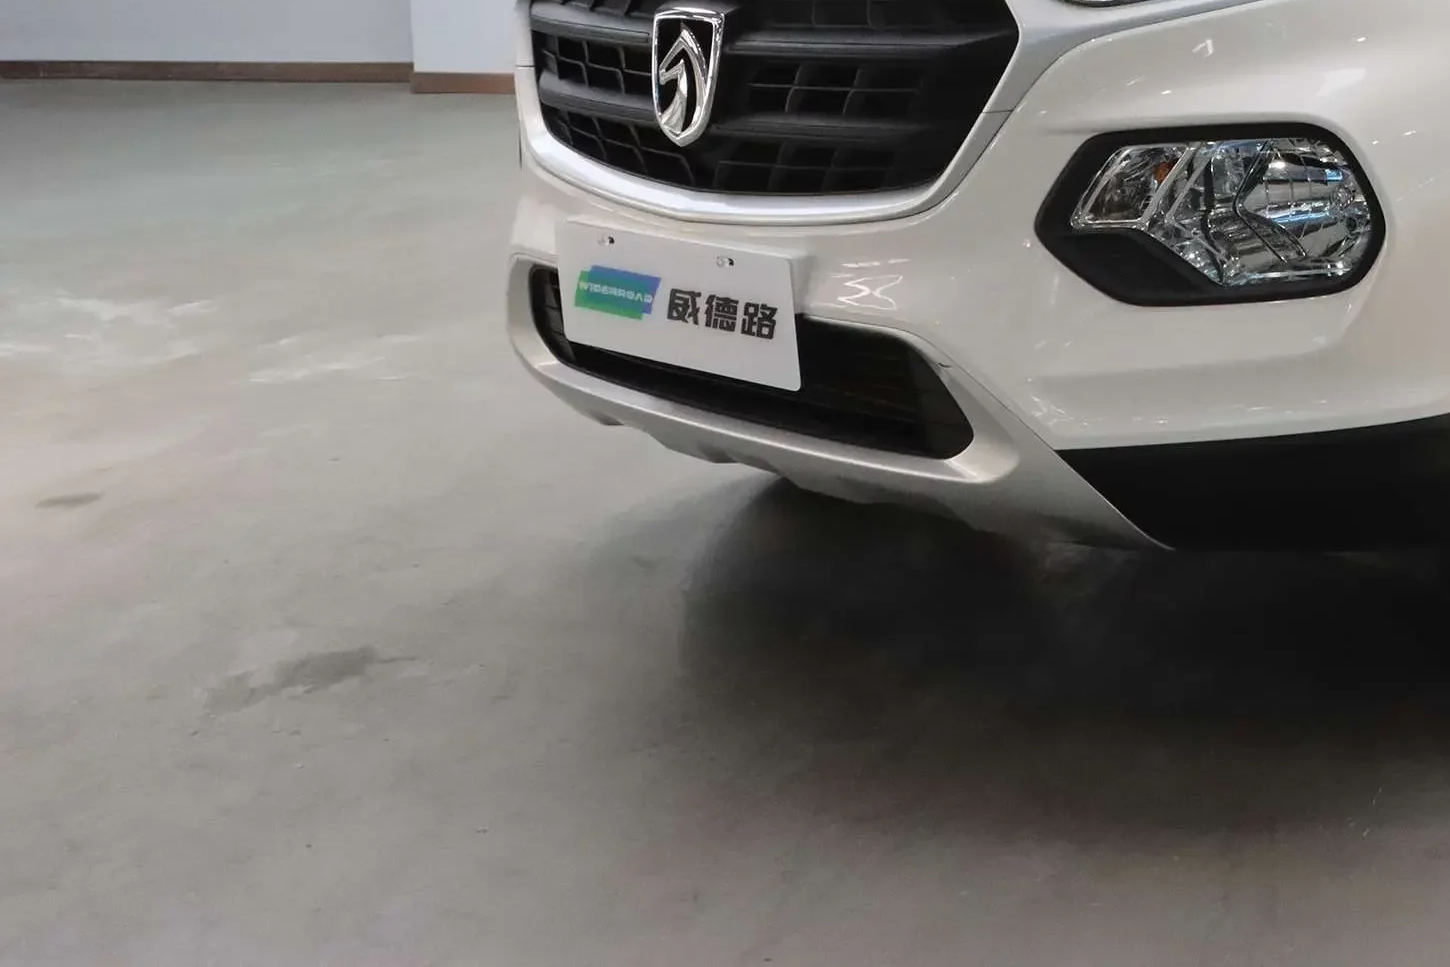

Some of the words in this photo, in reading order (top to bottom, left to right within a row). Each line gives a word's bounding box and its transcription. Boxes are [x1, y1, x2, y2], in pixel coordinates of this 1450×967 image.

[579, 280, 653, 304] WIDERROAD
[666, 288, 778, 340] 威德路
